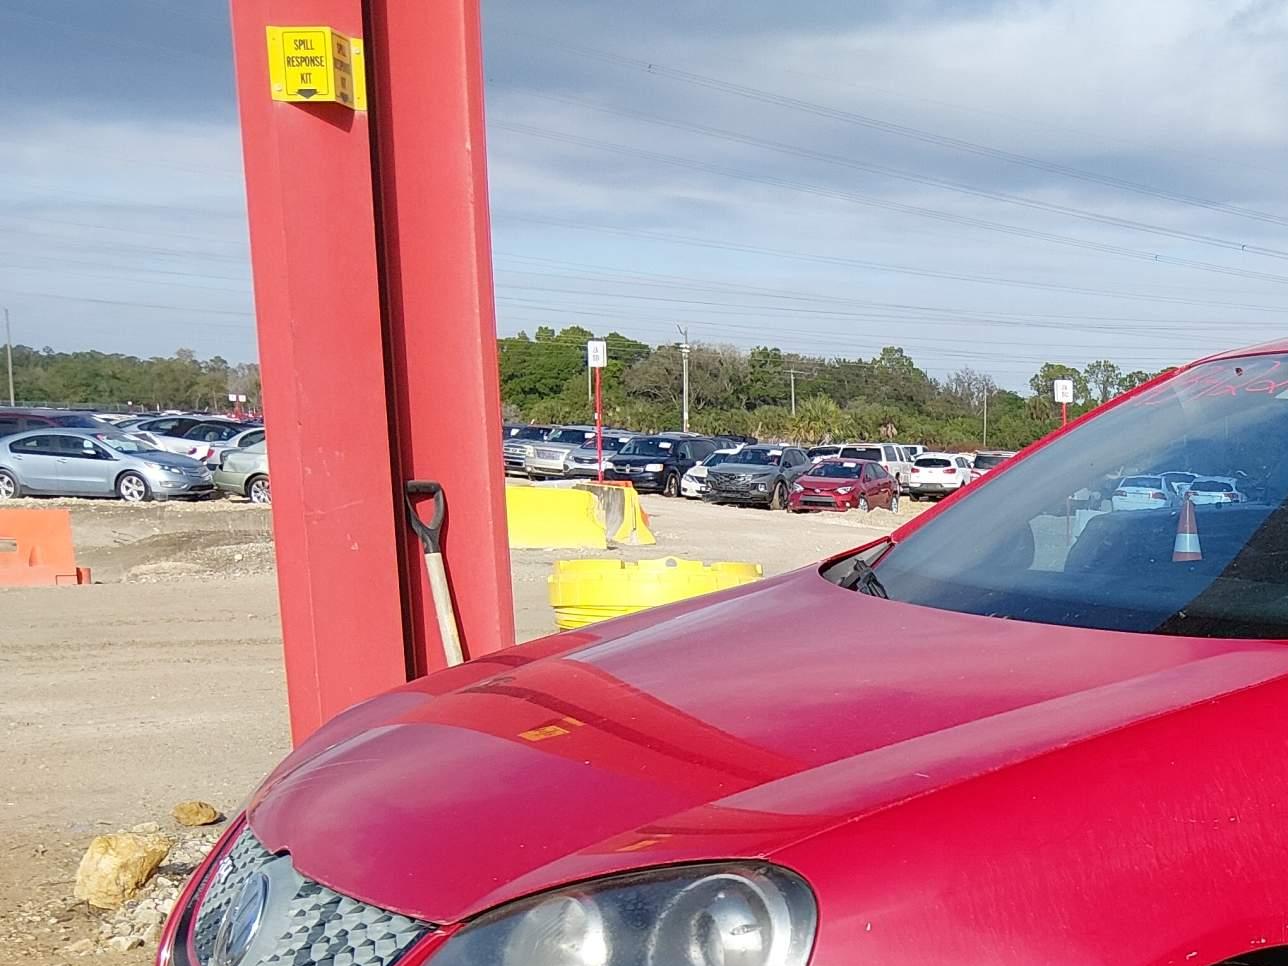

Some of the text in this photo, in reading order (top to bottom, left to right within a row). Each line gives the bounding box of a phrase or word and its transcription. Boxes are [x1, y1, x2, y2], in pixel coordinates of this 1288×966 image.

[293, 39, 315, 51] SPILL
[286, 55, 325, 68] RESPONSE
[300, 72, 313, 84] KIT
